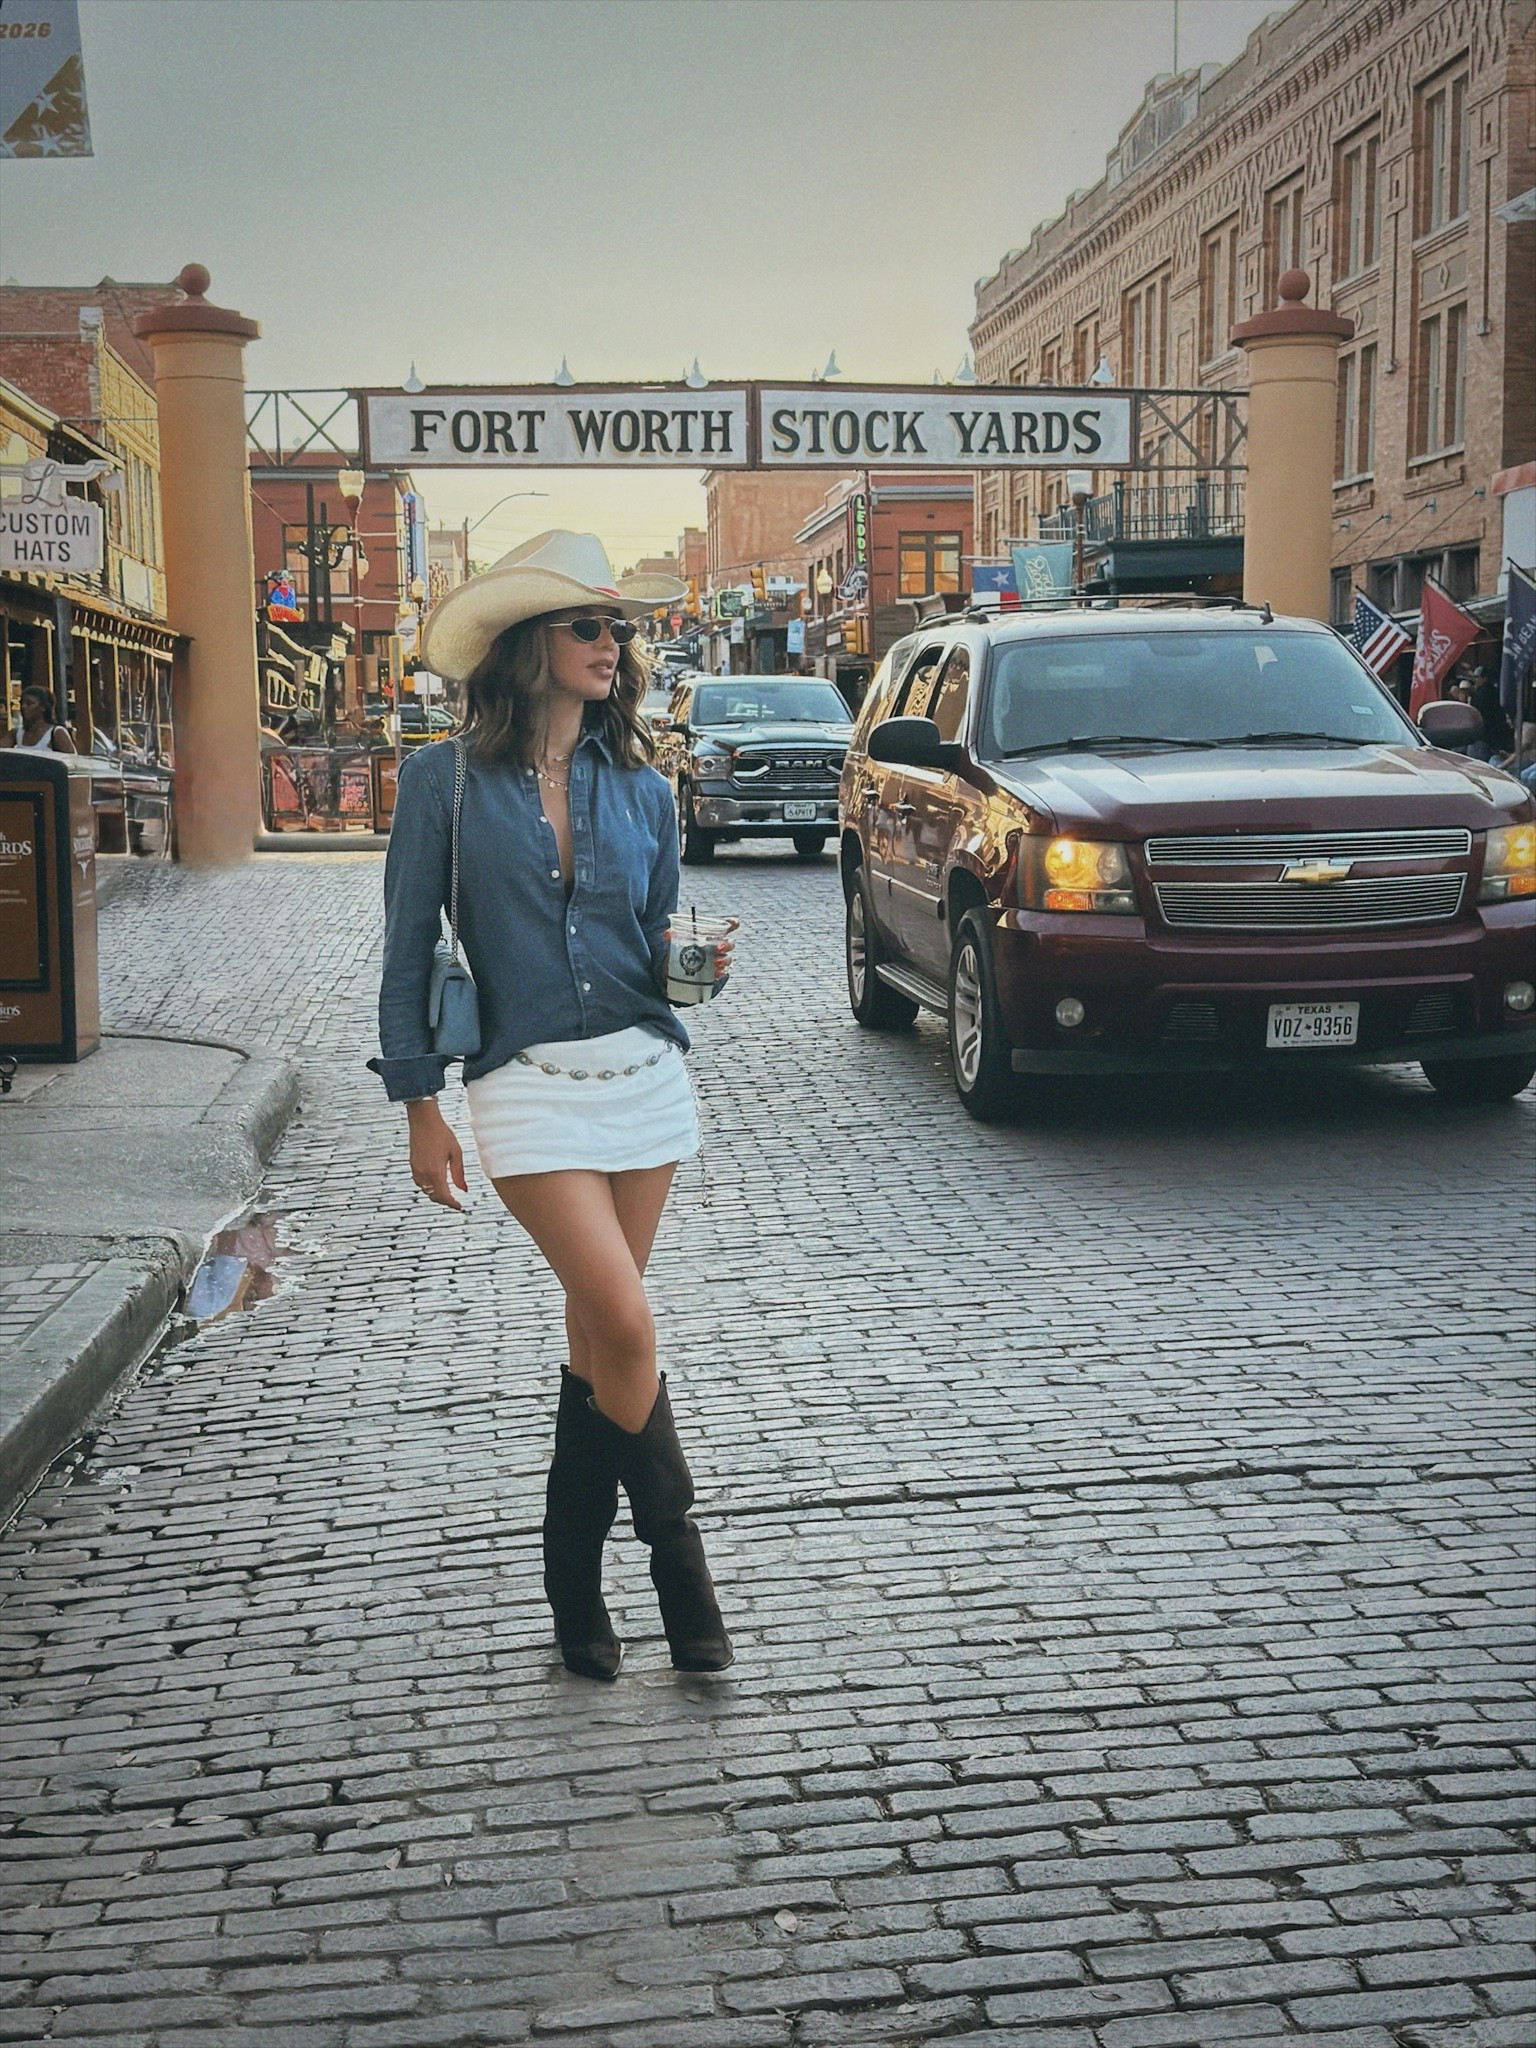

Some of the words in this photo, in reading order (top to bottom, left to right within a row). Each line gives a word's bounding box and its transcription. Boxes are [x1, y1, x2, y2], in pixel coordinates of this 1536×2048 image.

[0, 22, 52, 39] 2026
[410, 409, 546, 454] FORT
[567, 409, 734, 454] WORTH
[771, 409, 928, 455] STOCK
[950, 409, 1103, 455] YARDS
[14, 540, 71, 562] HATS
[775, 759, 823, 769] RAM
[0, 840, 32, 856] RDS
[1297, 1005, 1332, 1015] TEXAS
[1313, 1016, 1352, 1037] 9356
